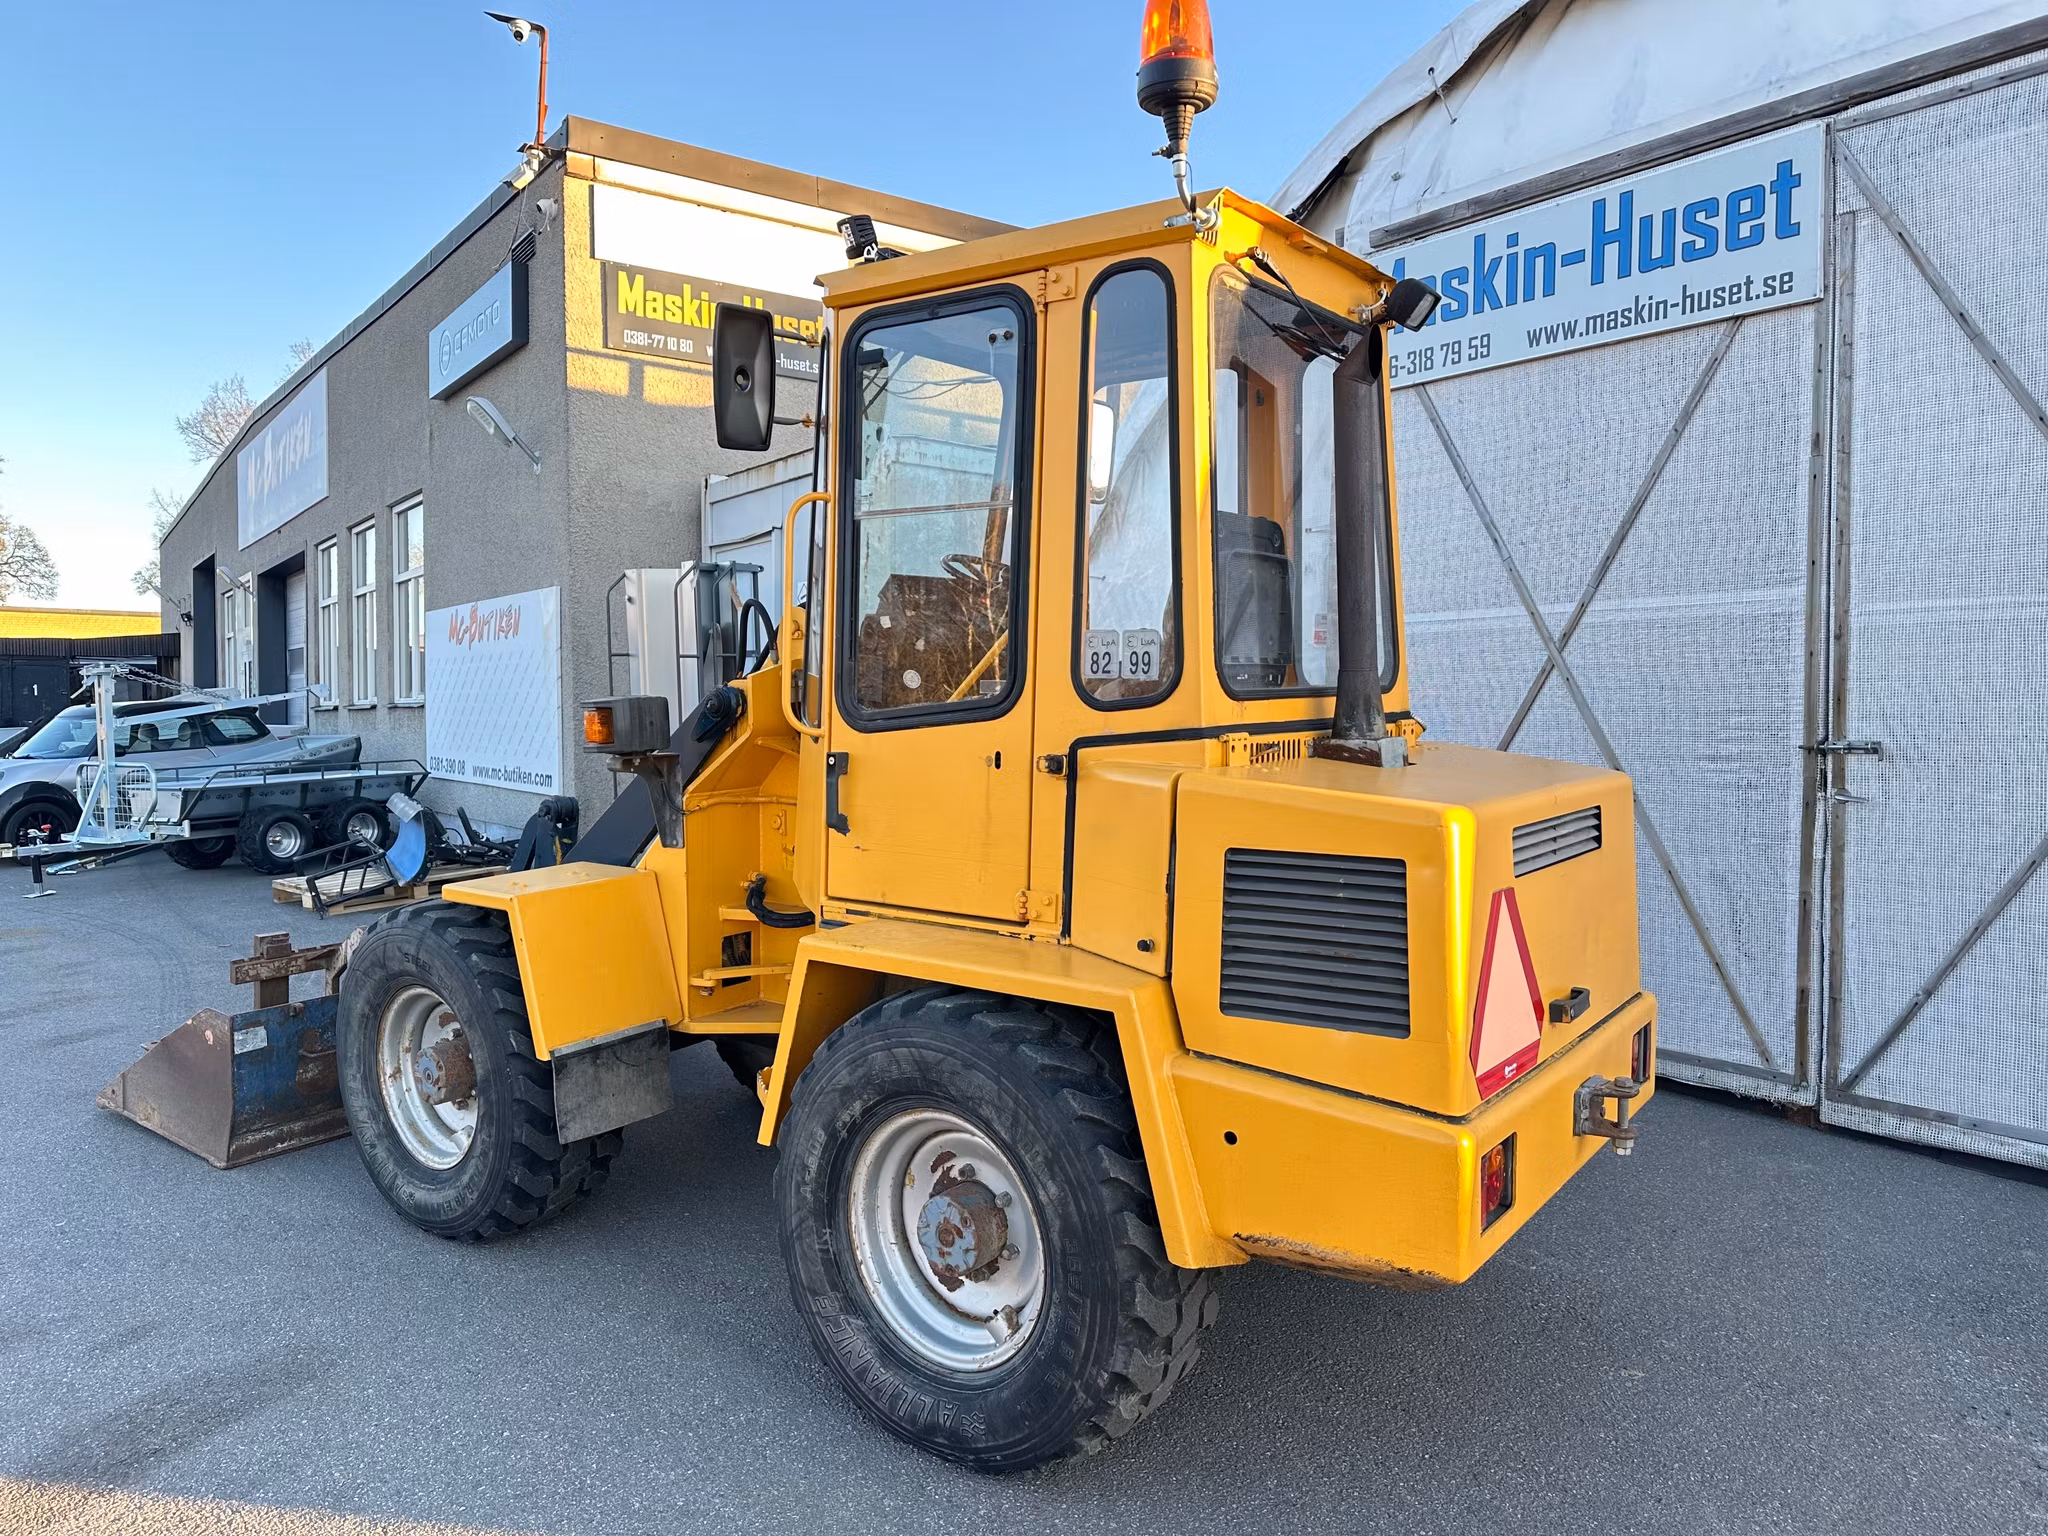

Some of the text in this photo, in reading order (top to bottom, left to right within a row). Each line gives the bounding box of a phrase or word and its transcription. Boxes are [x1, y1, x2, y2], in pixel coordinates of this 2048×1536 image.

[1526, 270, 1794, 348] www.maskin-huset.se
[623, 329, 693, 354] 0381-77 10 80
[1440, 339, 1462, 368] 79
[1467, 332, 1491, 362] 59
[1090, 651, 1112, 675] 82
[1129, 650, 1151, 675] 99
[32, 684, 38, 696] 1
[429, 756, 466, 776] 0381-390 08
[472, 765, 553, 788] www.mc-butiken.com
[815, 1291, 960, 1430] ALLIANCE
